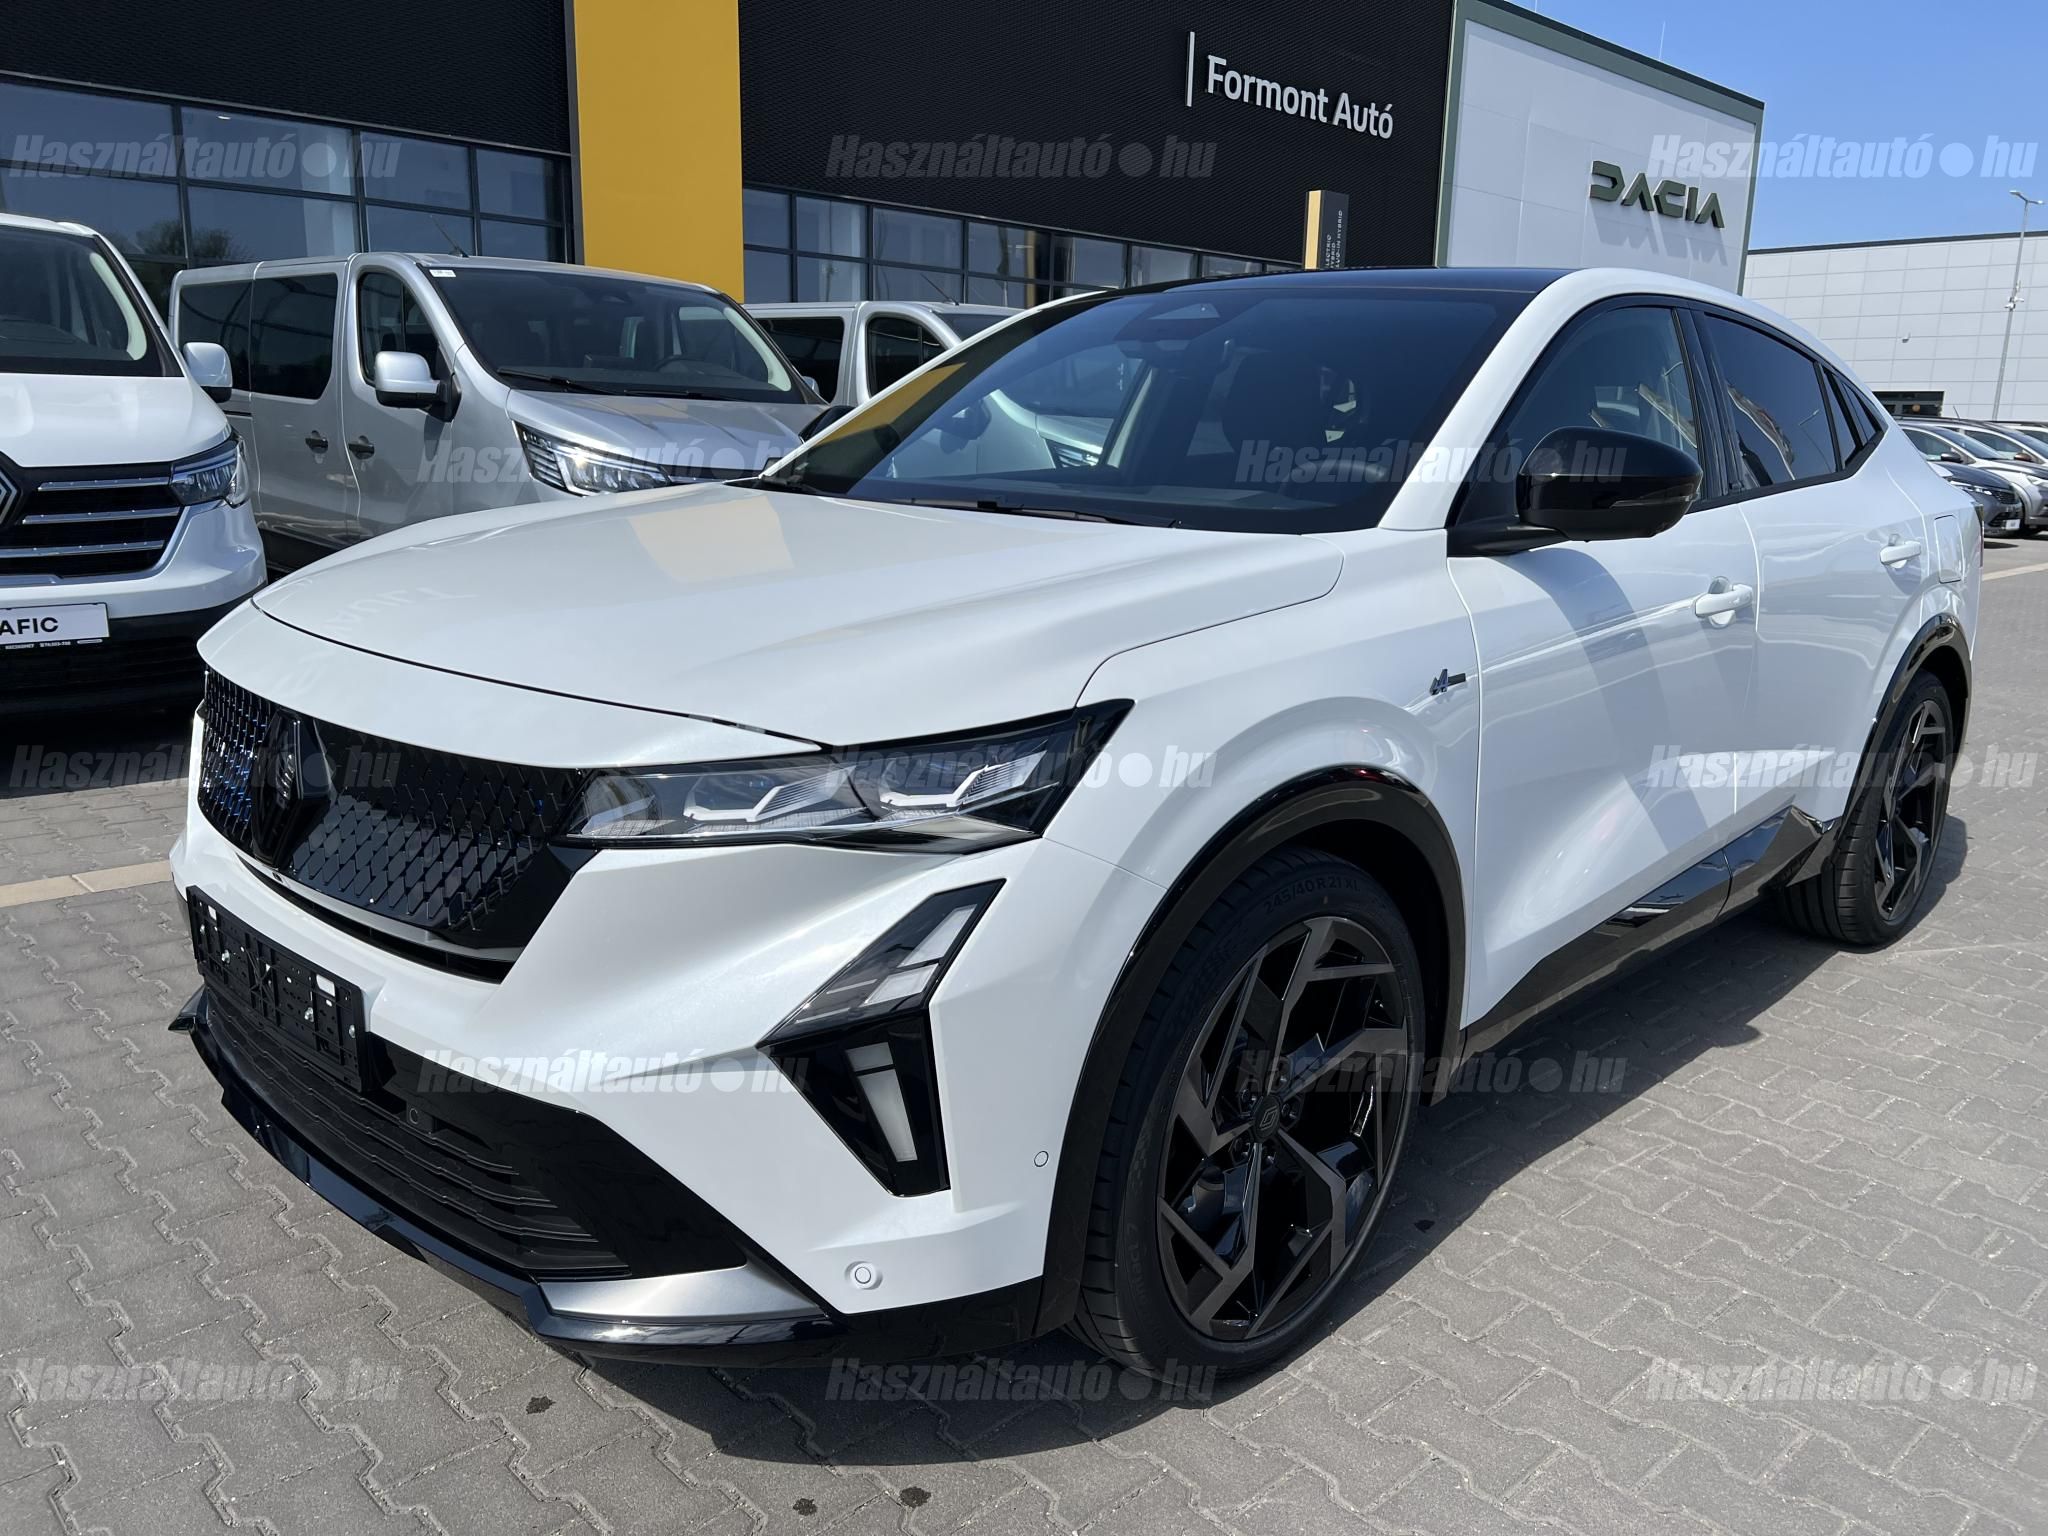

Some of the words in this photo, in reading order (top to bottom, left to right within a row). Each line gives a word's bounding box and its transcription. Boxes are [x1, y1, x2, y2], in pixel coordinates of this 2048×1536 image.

[1207, 54, 1328, 124] Formont
[1332, 92, 1394, 140] Autó
[1588, 160, 1726, 229] DACIA
